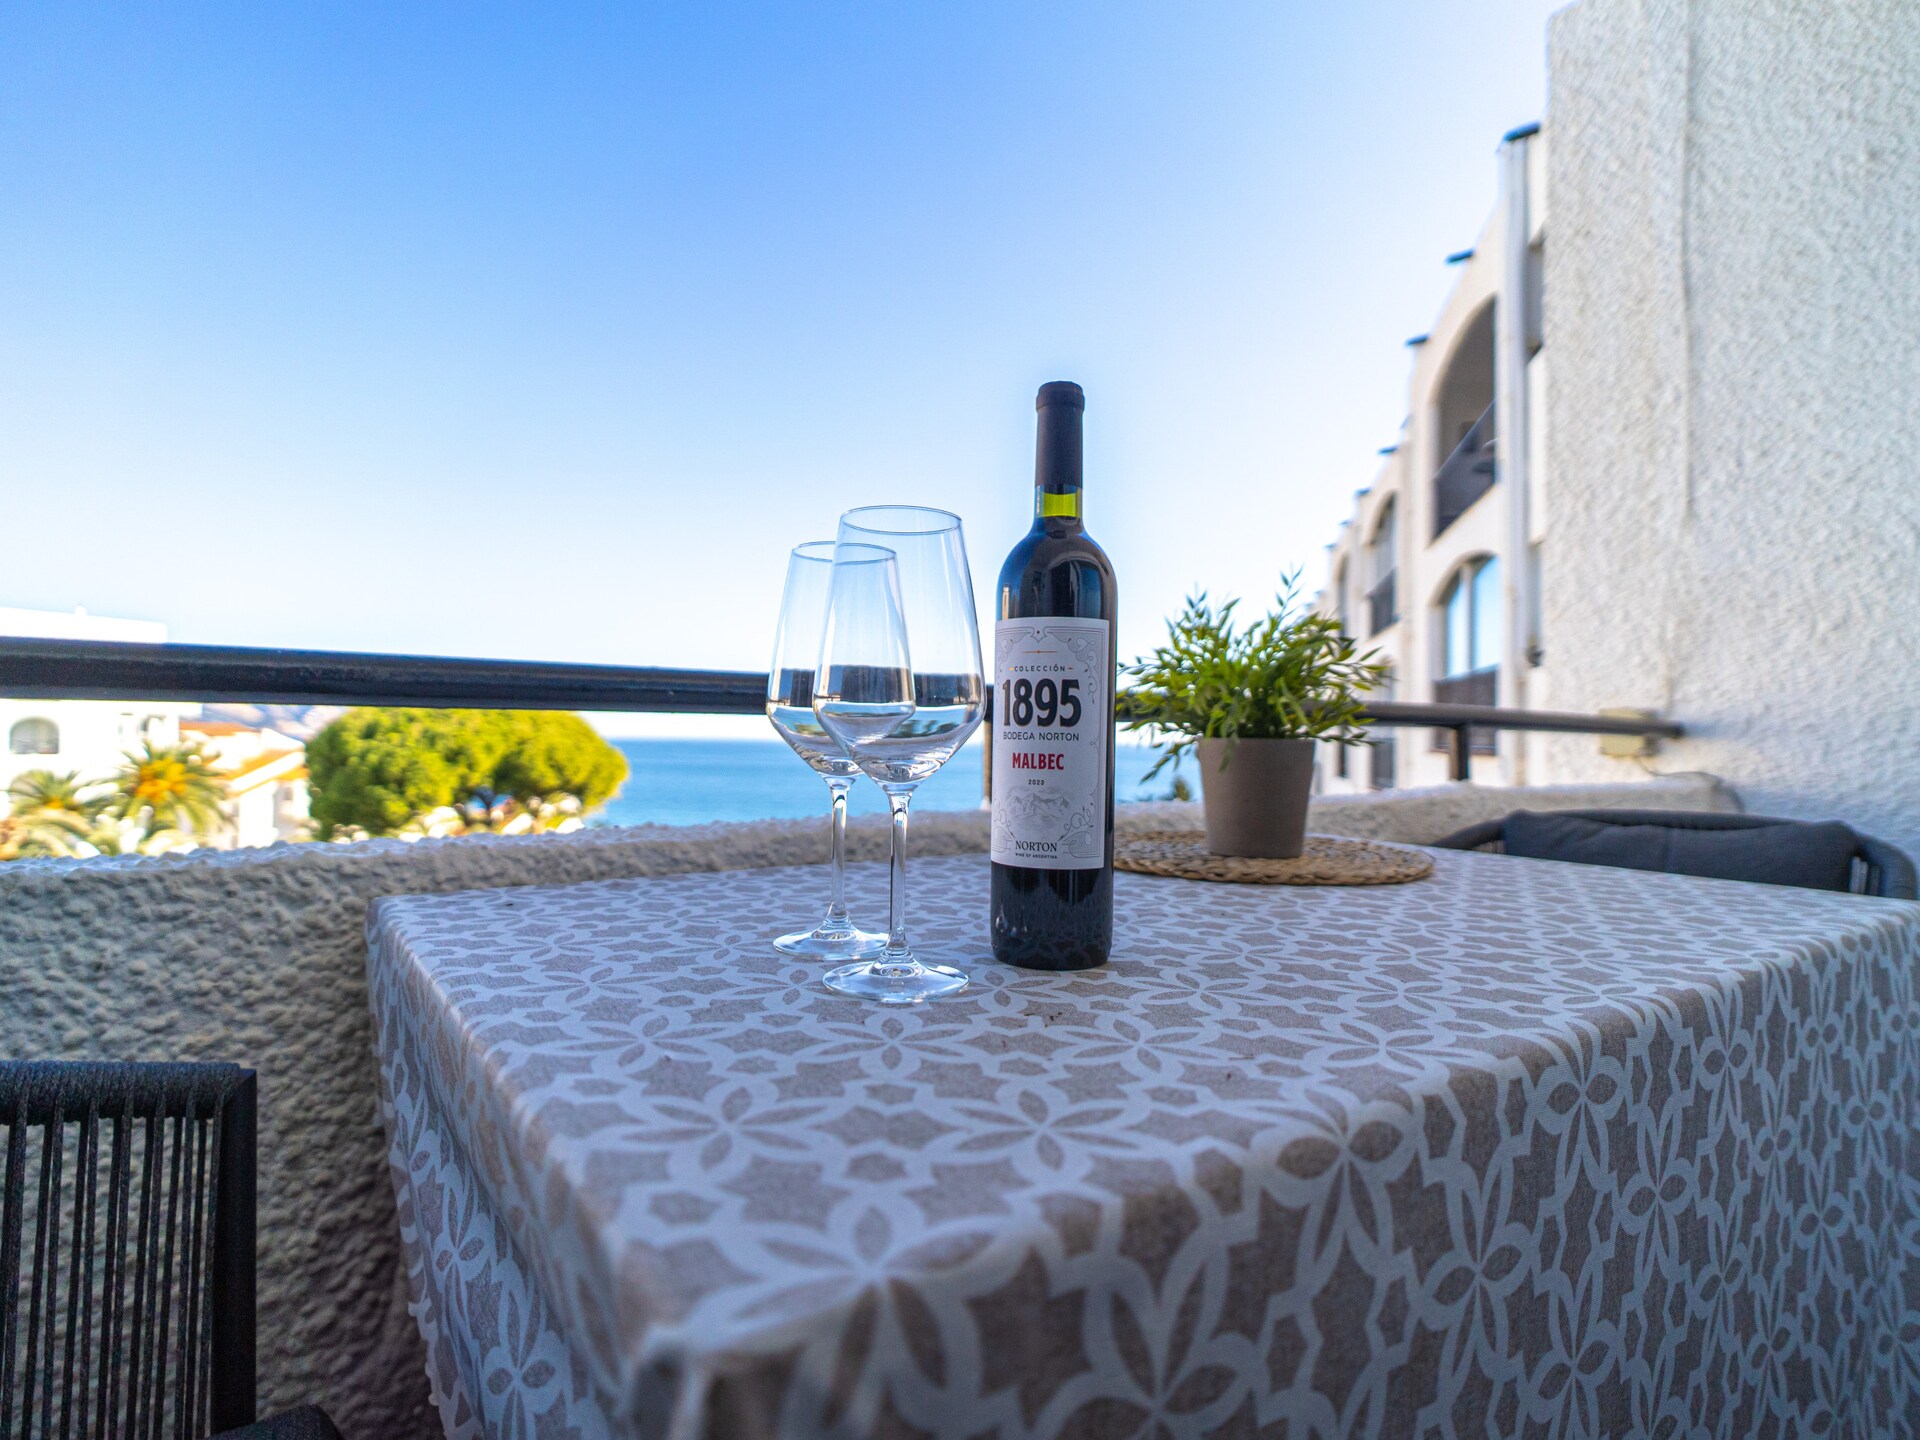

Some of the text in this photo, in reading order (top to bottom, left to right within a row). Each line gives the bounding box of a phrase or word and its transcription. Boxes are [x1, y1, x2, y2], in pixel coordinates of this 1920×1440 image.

[1014, 664, 1066, 672] COLECCIÓN
[1002, 678, 1082, 728] 1895
[1003, 731, 1080, 742] BODEGA NORTON
[1012, 752, 1065, 770] MALBEC
[1015, 840, 1057, 852] NORTON
